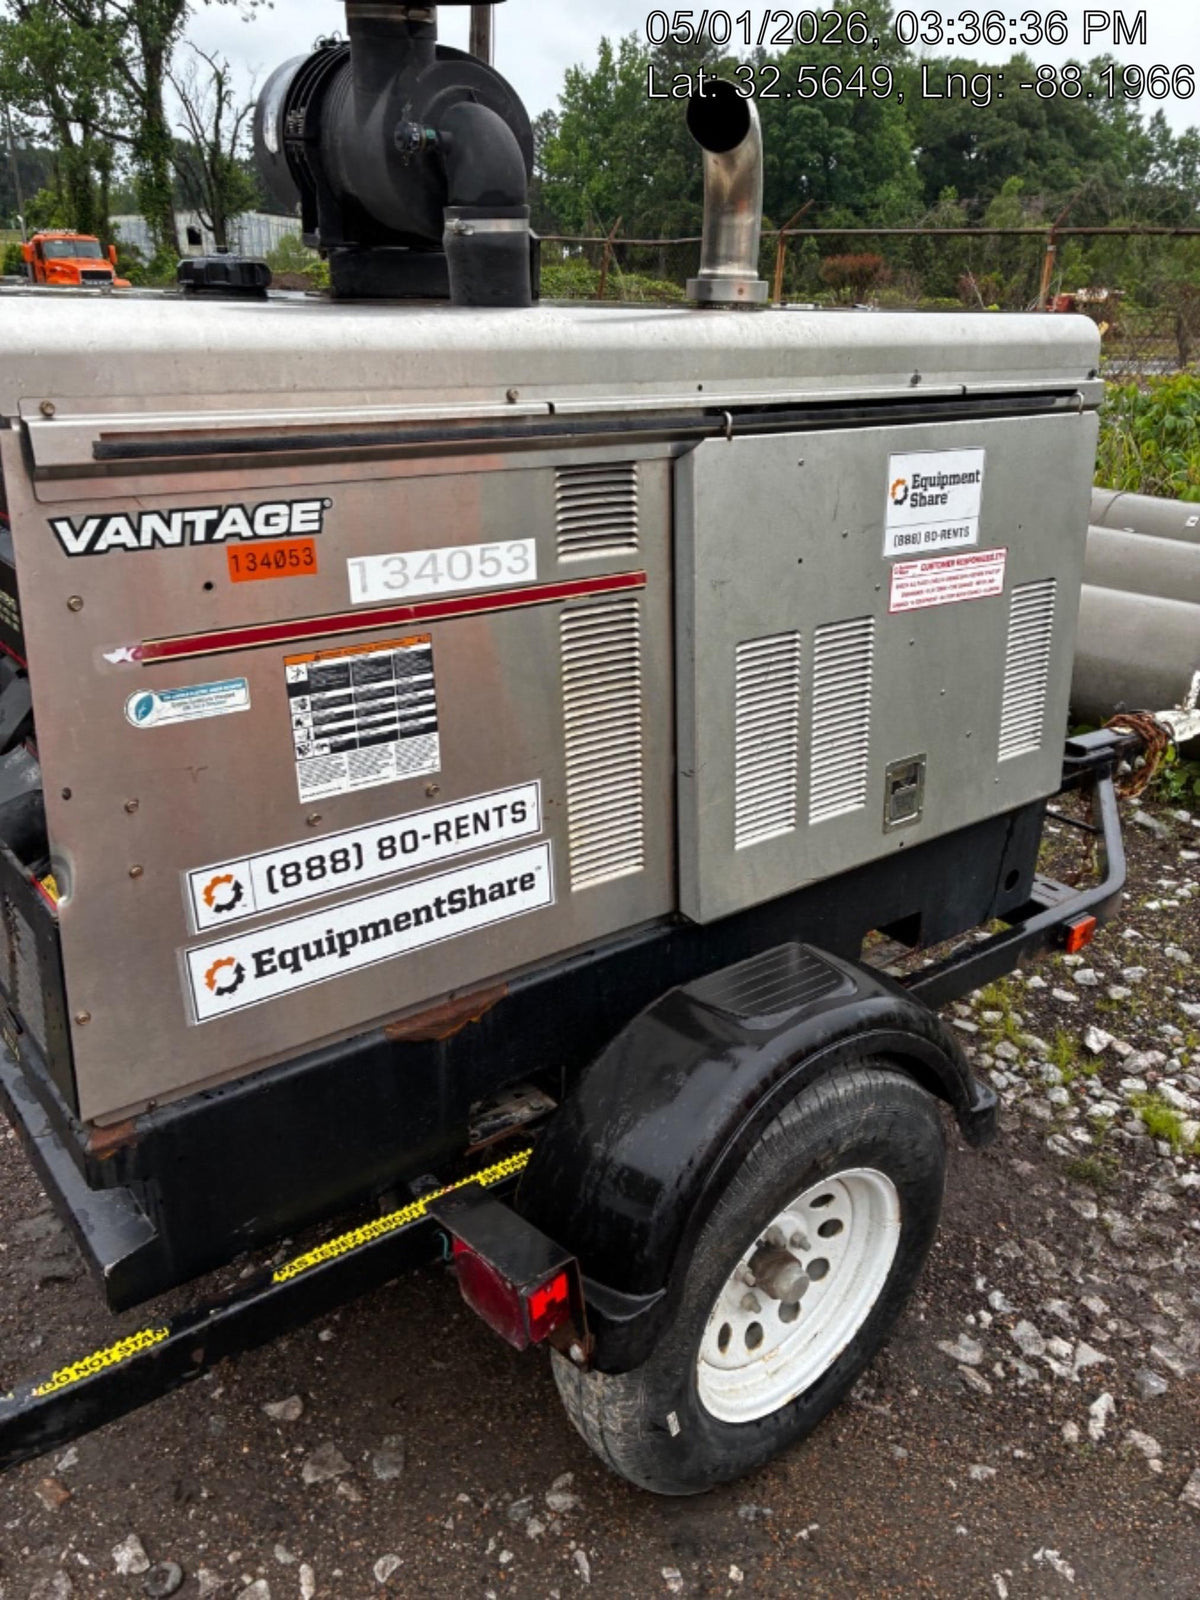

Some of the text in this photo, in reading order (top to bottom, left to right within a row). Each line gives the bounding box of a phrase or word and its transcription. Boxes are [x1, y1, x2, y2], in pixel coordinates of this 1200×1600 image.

[911, 469, 981, 491] Equipment
[910, 492, 948, 508] Share
[50, 499, 322, 556] VANTAGE
[894, 526, 970, 548] (888) 80-RENTS
[231, 547, 314, 573] 134053
[350, 543, 530, 593] 134053
[265, 800, 527, 894] (888) 80-RENTS
[251, 872, 536, 980] EquipmentShare
[74, 1353, 113, 1375] NOT
